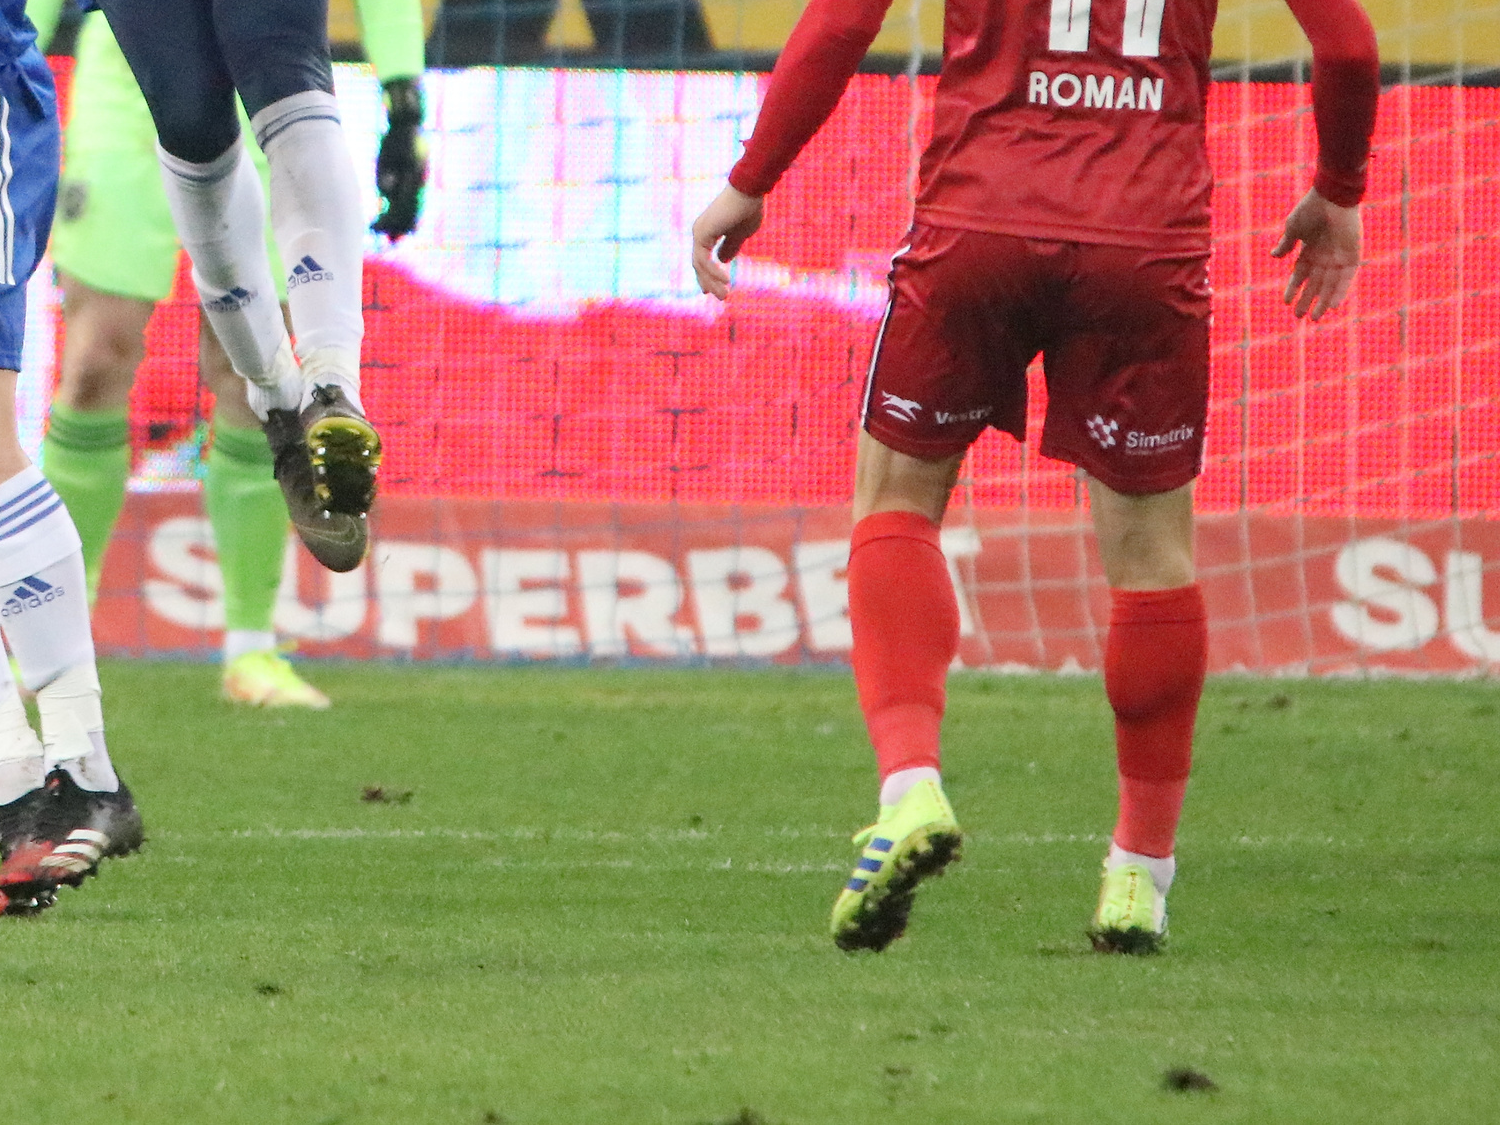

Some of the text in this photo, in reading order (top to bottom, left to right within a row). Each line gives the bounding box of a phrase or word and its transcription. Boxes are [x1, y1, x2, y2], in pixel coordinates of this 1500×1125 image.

[1028, 71, 1165, 111] ROMAN
[1125, 424, 1195, 448] Simetrix
[1, 586, 65, 618] adidas
